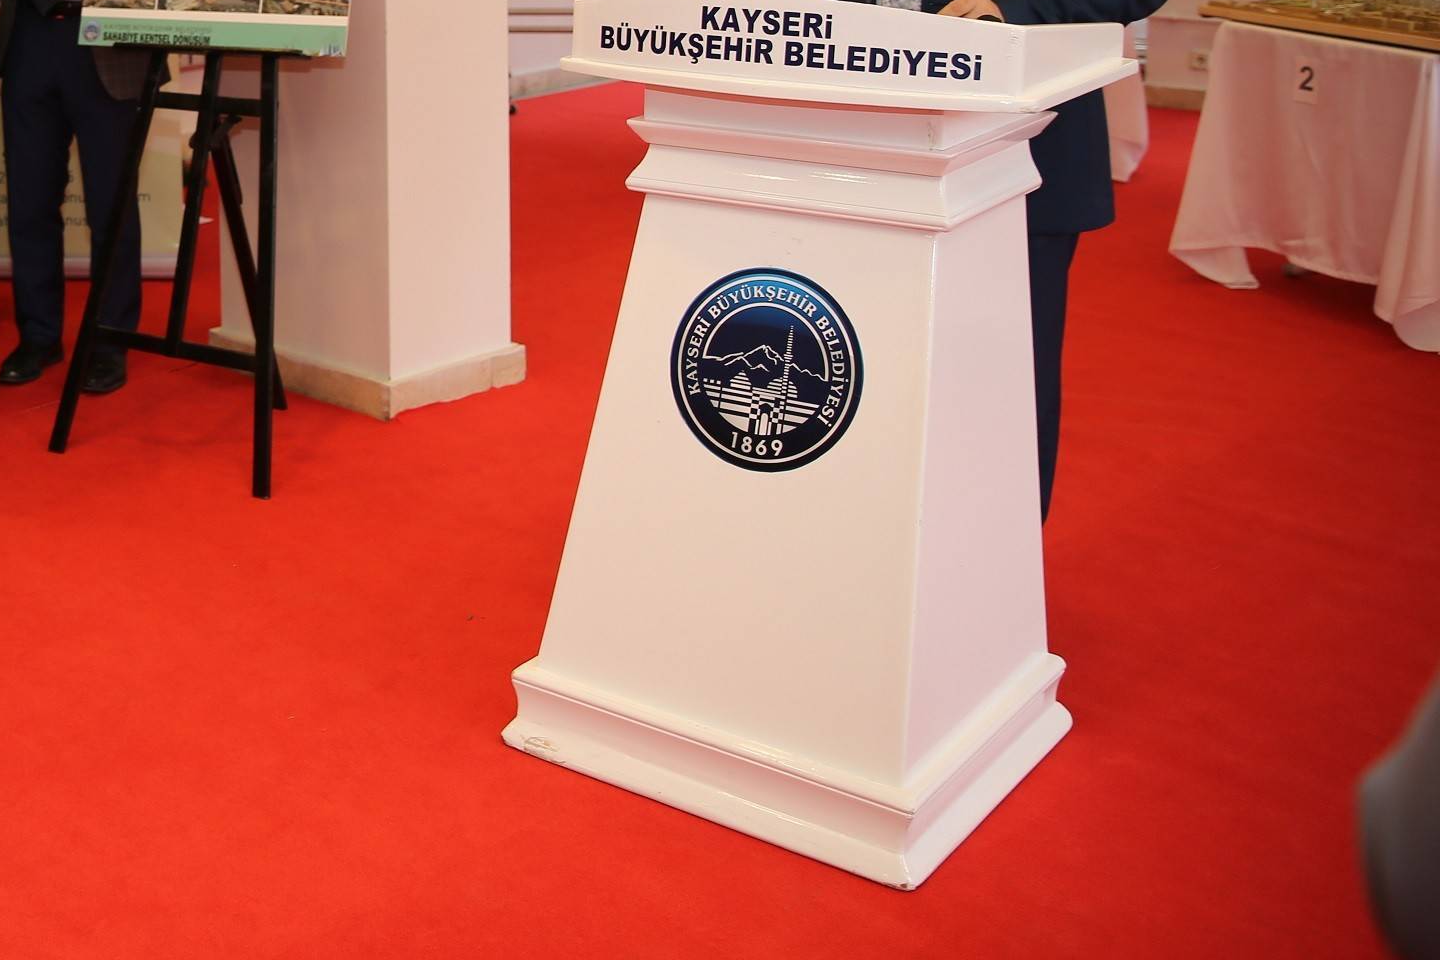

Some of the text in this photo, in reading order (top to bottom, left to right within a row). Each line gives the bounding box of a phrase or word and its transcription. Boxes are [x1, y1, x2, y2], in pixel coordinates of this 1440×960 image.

[1299, 66, 1314, 91] 2
[686, 284, 849, 428] KAYSERİ BÜYÜKŞEHİR BELEDİYESİ
[731, 431, 784, 457] 1869
